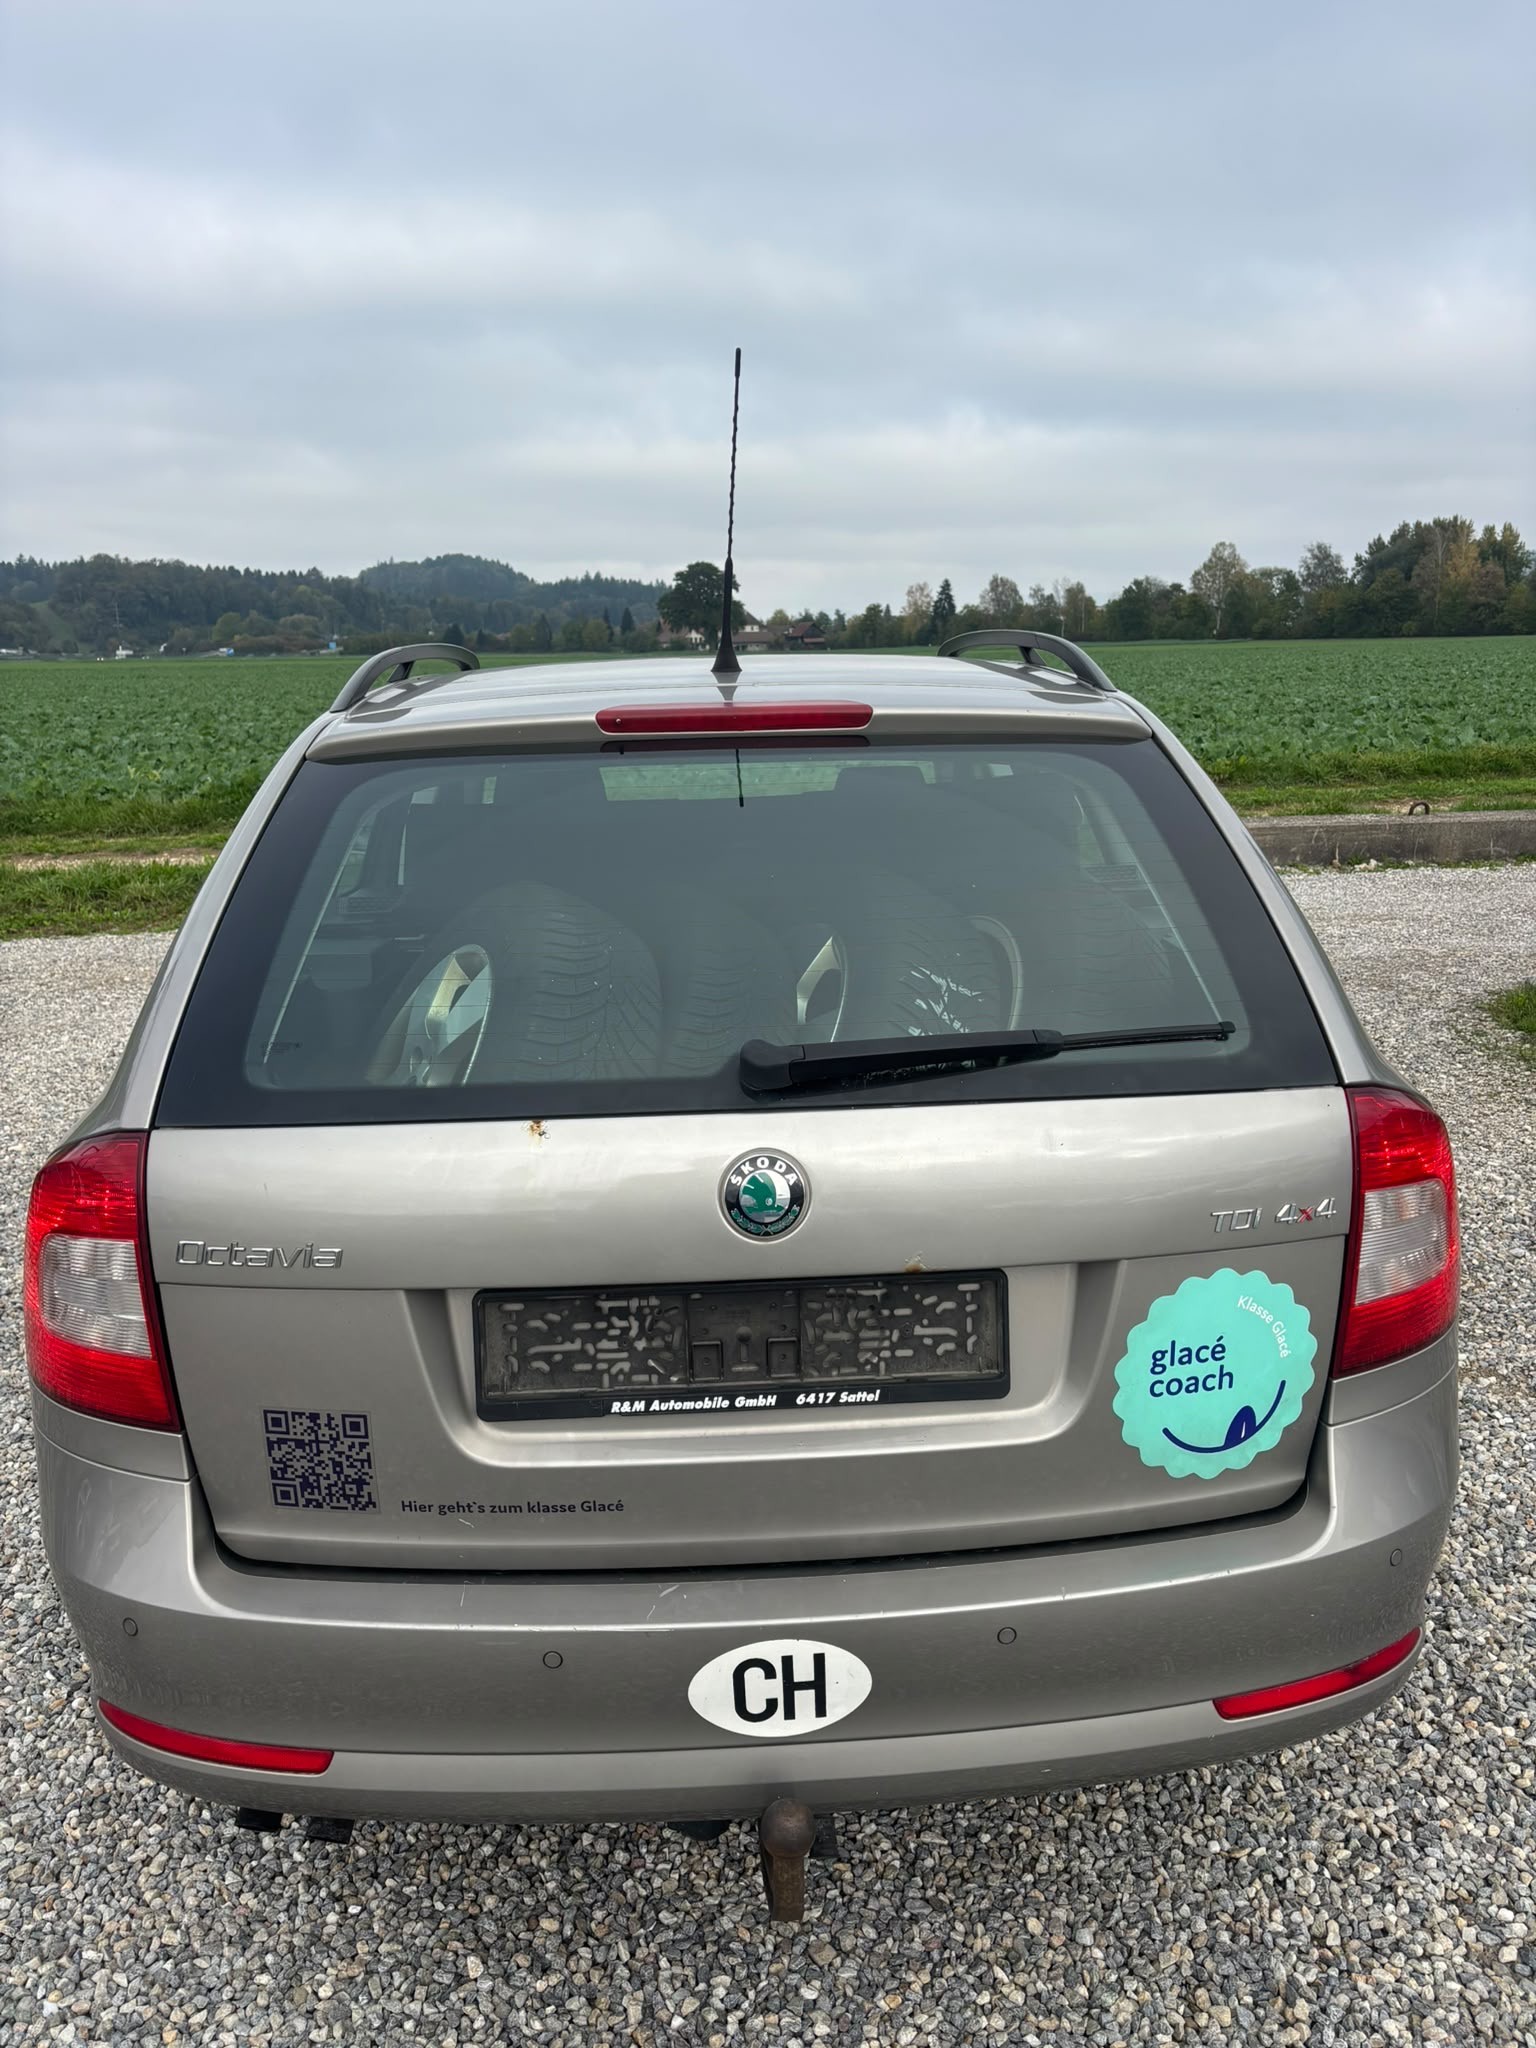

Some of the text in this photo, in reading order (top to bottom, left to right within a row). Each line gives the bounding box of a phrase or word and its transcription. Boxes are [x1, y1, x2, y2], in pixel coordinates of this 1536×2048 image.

[730, 1156, 798, 1187] SKODA
[1211, 1197, 1337, 1233] TDI 4x4
[176, 1240, 343, 1268] Octavia
[1237, 1295, 1292, 1359] Klasse Glacé
[1150, 1335, 1226, 1375] glacé
[1149, 1364, 1234, 1398] coach
[611, 1389, 881, 1414] R&M Automobile GmbH 6417 Sattel
[401, 1500, 434, 1513] Hier
[489, 1504, 523, 1514] zum
[527, 1502, 577, 1514] klasse
[580, 1499, 625, 1513] Glacé
[732, 1652, 828, 1723] CH
